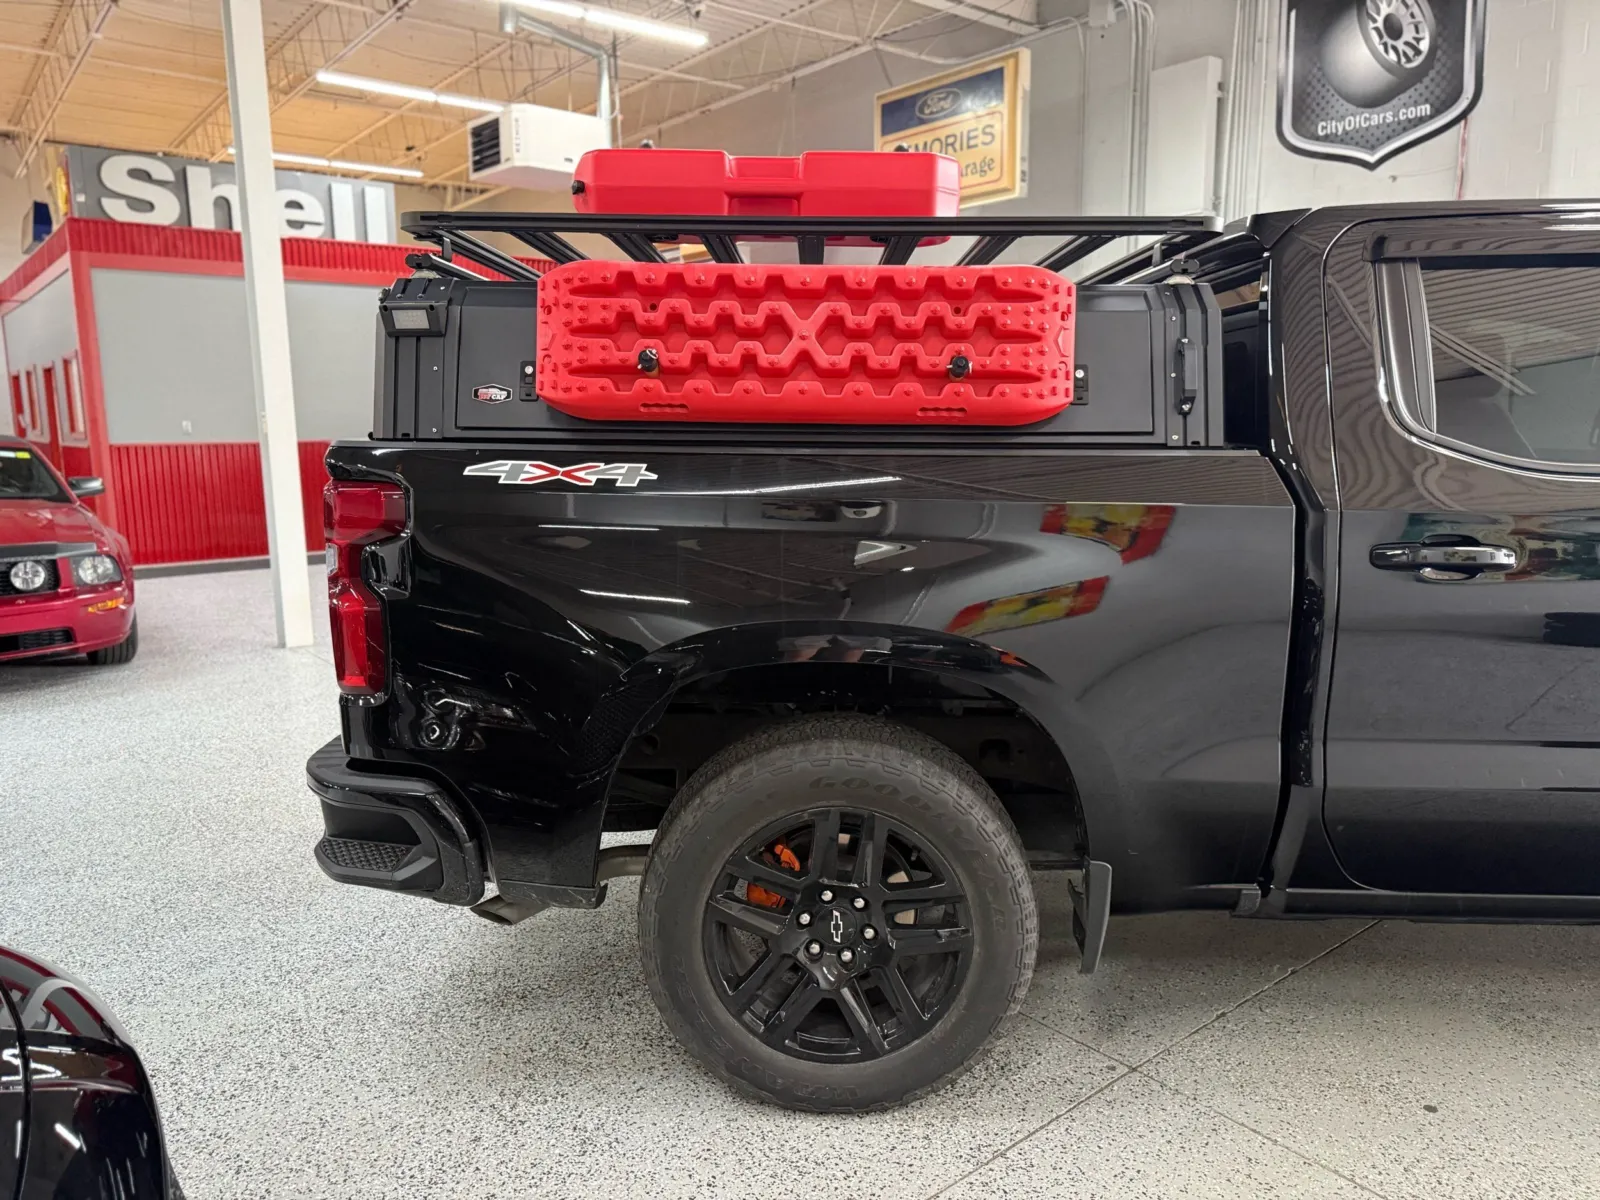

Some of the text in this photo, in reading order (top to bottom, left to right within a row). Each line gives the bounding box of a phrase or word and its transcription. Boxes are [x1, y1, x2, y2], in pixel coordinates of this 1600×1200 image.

[1317, 103, 1431, 136] CityOfCars.com
[907, 124, 995, 155] MORIES
[960, 156, 995, 178] rage
[99, 154, 389, 244] Shell
